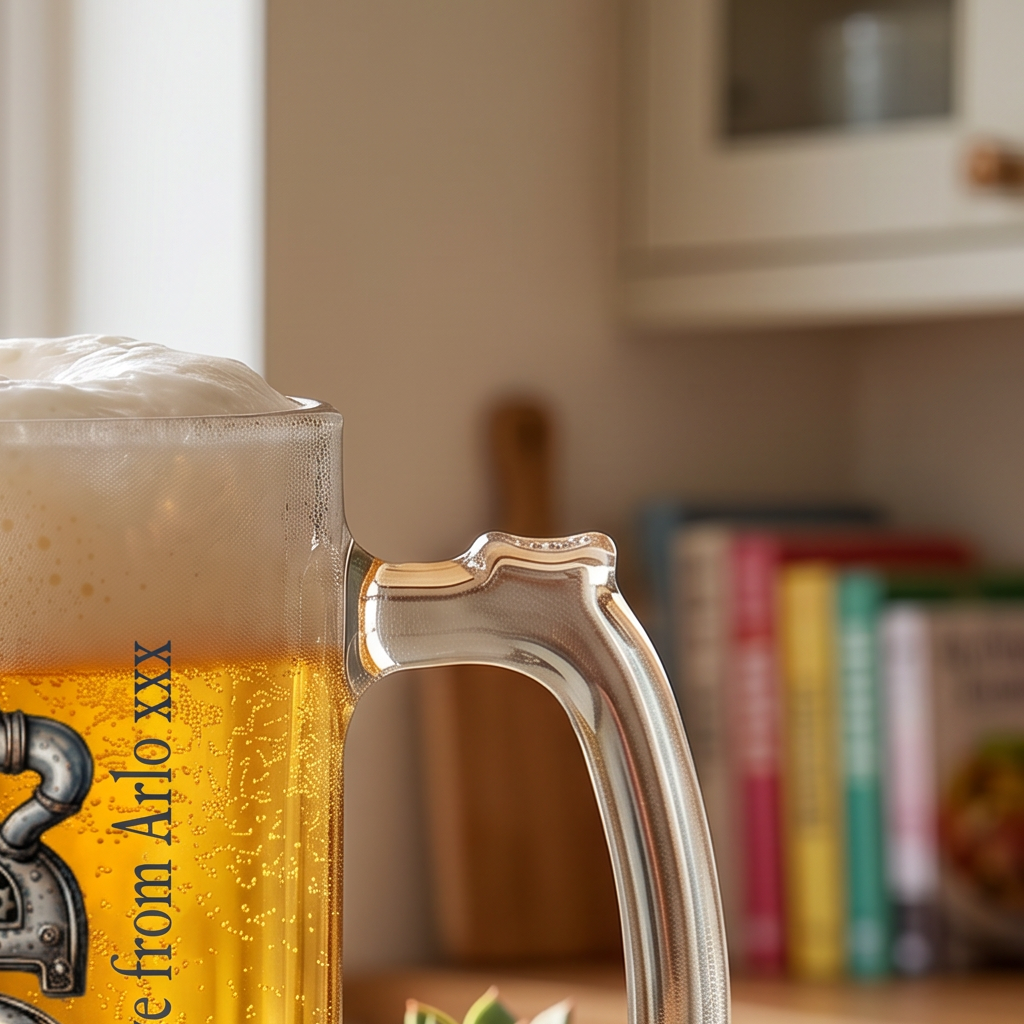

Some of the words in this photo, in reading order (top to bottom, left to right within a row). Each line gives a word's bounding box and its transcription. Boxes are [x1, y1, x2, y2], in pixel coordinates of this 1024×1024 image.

[134, 639, 172, 722] xxx
[110, 738, 171, 846] Arlo
[110, 861, 171, 980] from
